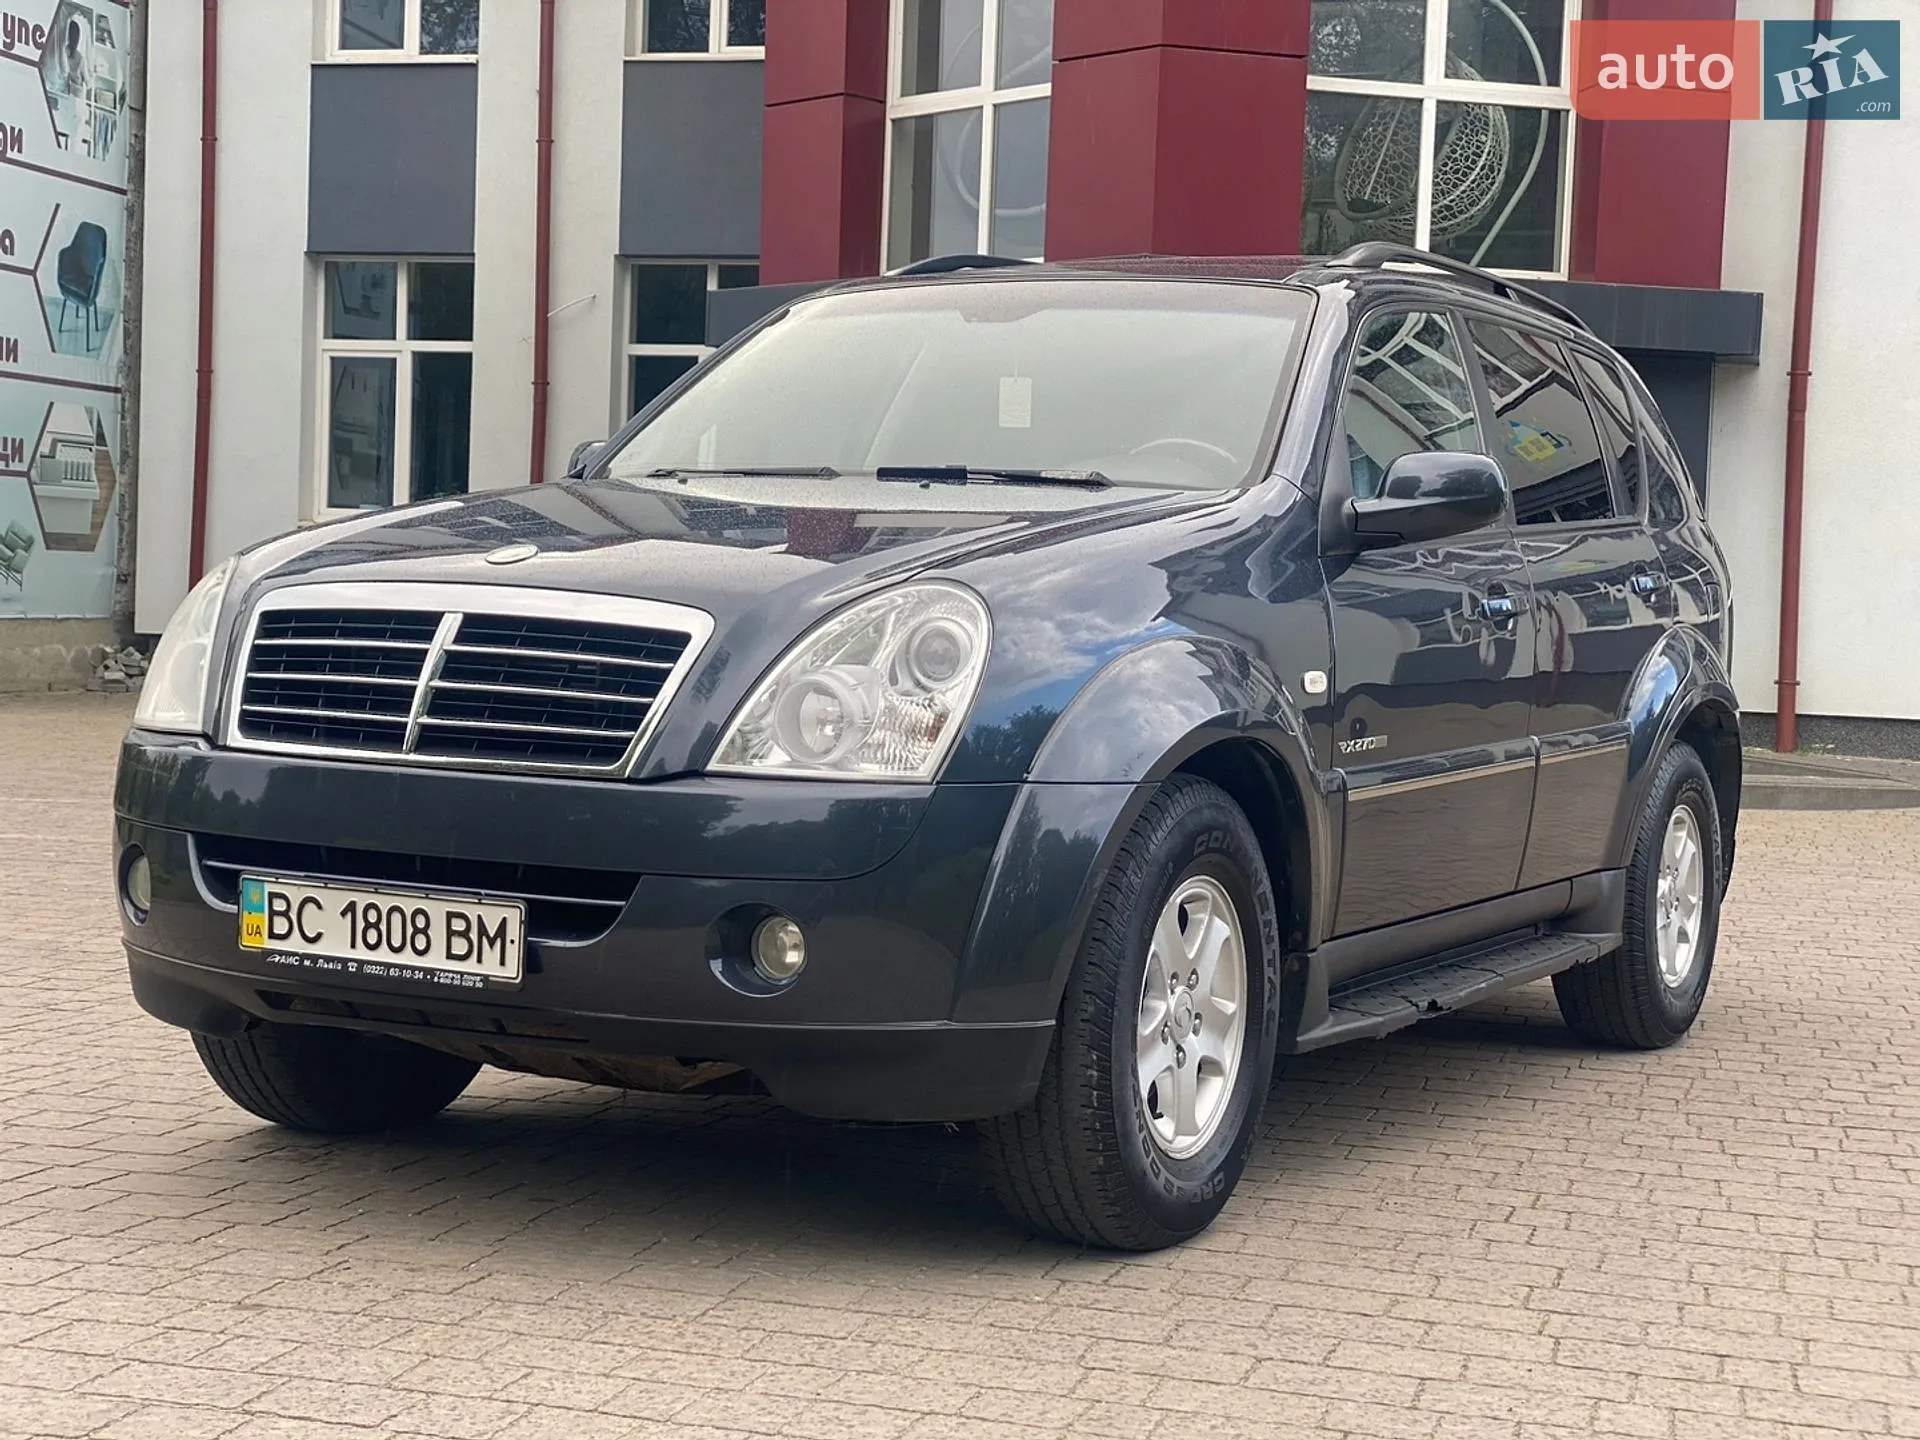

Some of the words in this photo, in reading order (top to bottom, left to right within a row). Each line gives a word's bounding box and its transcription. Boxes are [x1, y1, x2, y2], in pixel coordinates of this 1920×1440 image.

[246, 922, 263, 937] UA
[267, 890, 325, 944] BC
[339, 898, 432, 957] 1808
[445, 910, 508, 967] BM
